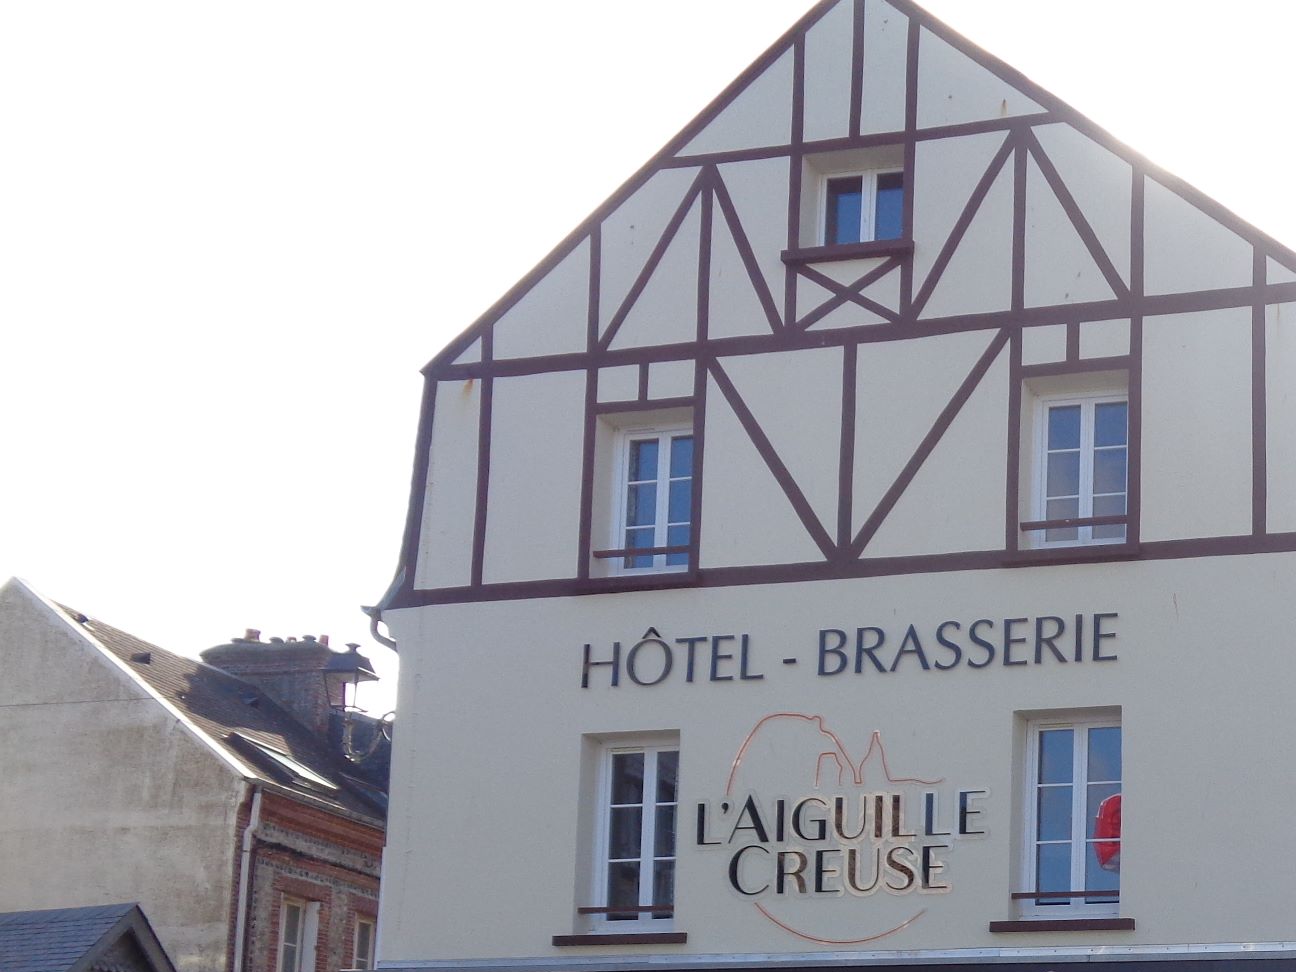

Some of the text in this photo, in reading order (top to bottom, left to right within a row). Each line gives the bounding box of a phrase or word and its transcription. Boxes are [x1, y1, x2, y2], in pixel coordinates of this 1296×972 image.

[580, 627, 764, 689] HÔTEL
[816, 612, 1119, 677] BRASSERIE
[696, 788, 988, 847] L'AIGUILLE
[728, 843, 951, 896] CREUSE
